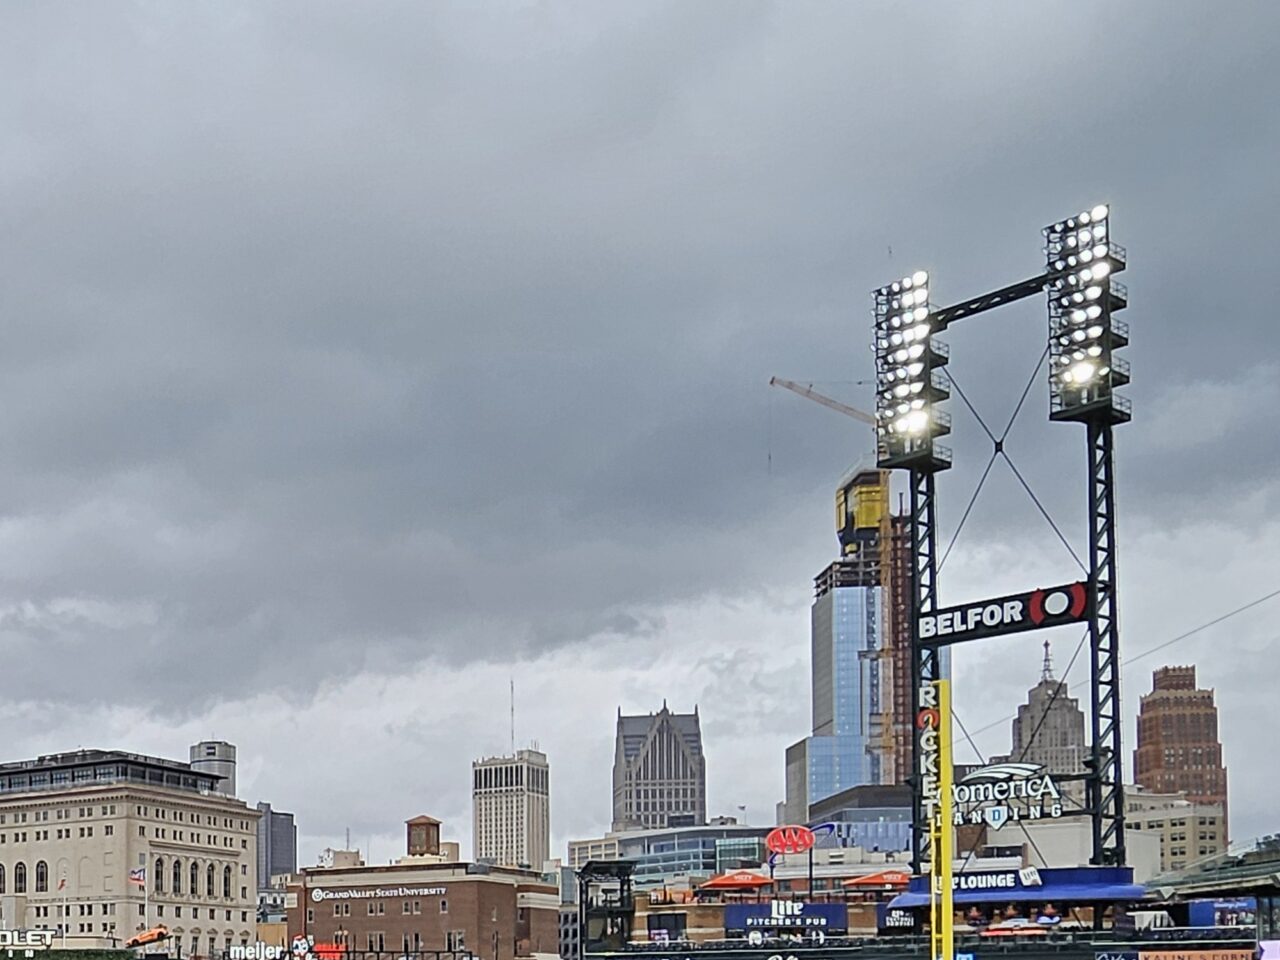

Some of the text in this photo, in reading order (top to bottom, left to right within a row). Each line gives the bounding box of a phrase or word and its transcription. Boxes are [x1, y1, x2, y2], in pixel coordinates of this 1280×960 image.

[919, 599, 1023, 639] BELFOR
[916, 687, 940, 818] ROCKET
[770, 827, 813, 853] AAA
[960, 874, 1015, 889] LOUNGE
[322, 887, 447, 899] GRAND VALLEY STATE UNIVERSITY
[771, 900, 804, 918] Lite
